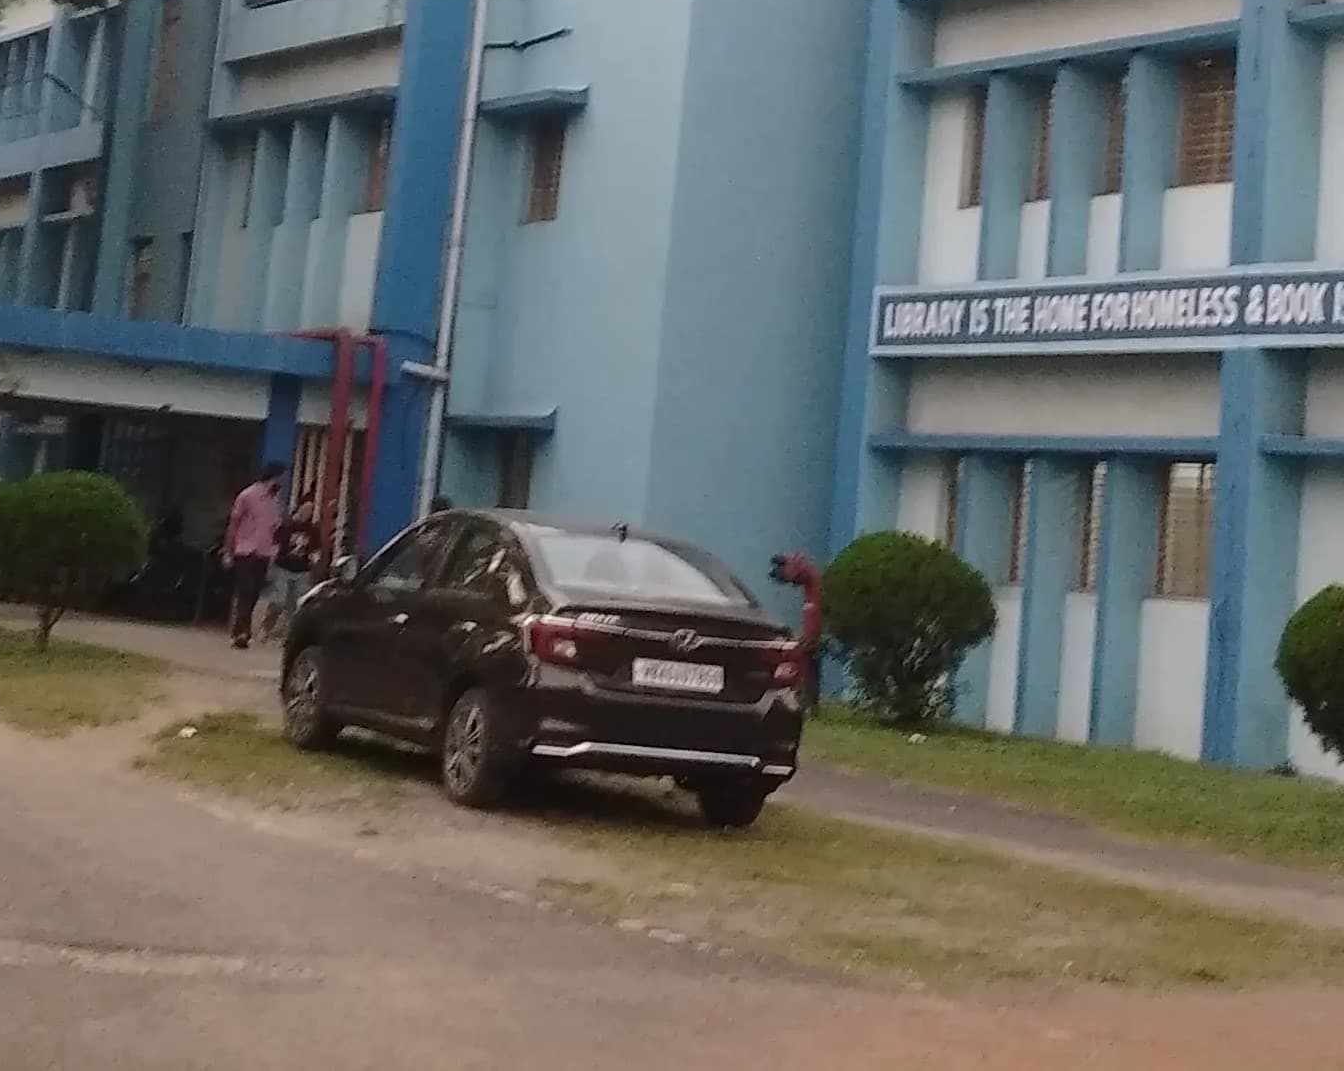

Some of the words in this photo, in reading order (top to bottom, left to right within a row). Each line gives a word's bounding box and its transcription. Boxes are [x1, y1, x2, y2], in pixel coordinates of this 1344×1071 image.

[883, 299, 967, 339] LIBRARY
[968, 298, 991, 336] IS
[992, 296, 1033, 336] THE
[1033, 293, 1089, 335] HOME
[1090, 291, 1131, 332] FOR
[1131, 284, 1241, 331] HOMELESS
[1244, 283, 1265, 325] &
[1266, 281, 1329, 326] BOOK
